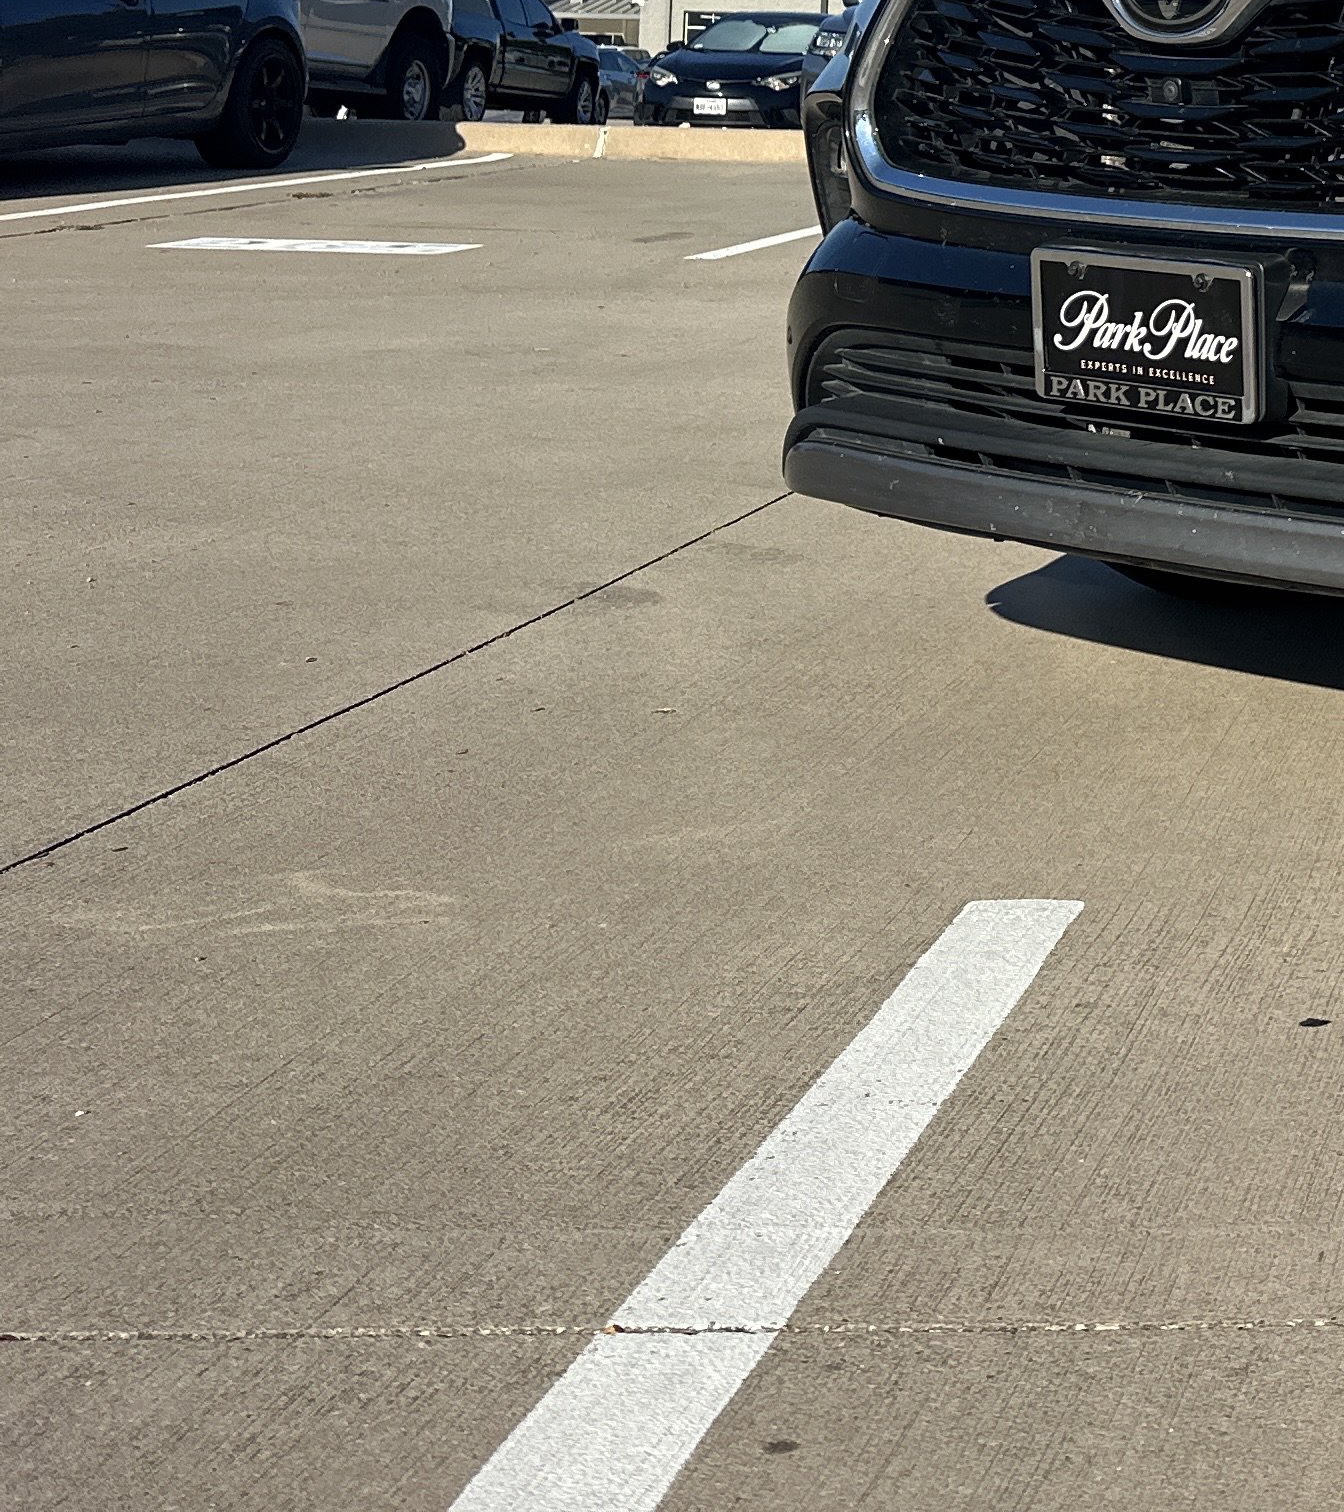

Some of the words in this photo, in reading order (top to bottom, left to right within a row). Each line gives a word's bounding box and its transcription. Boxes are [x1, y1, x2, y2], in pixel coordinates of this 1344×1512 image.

[1053, 290, 1148, 351] Park
[1142, 299, 1239, 364] Place
[1080, 359, 1127, 374] EXPERTS
[1132, 364, 1143, 376] IN
[1149, 368, 1215, 385] EXCELLENCE
[1050, 376, 1131, 406] PARK
[1137, 387, 1236, 419] PLACE
